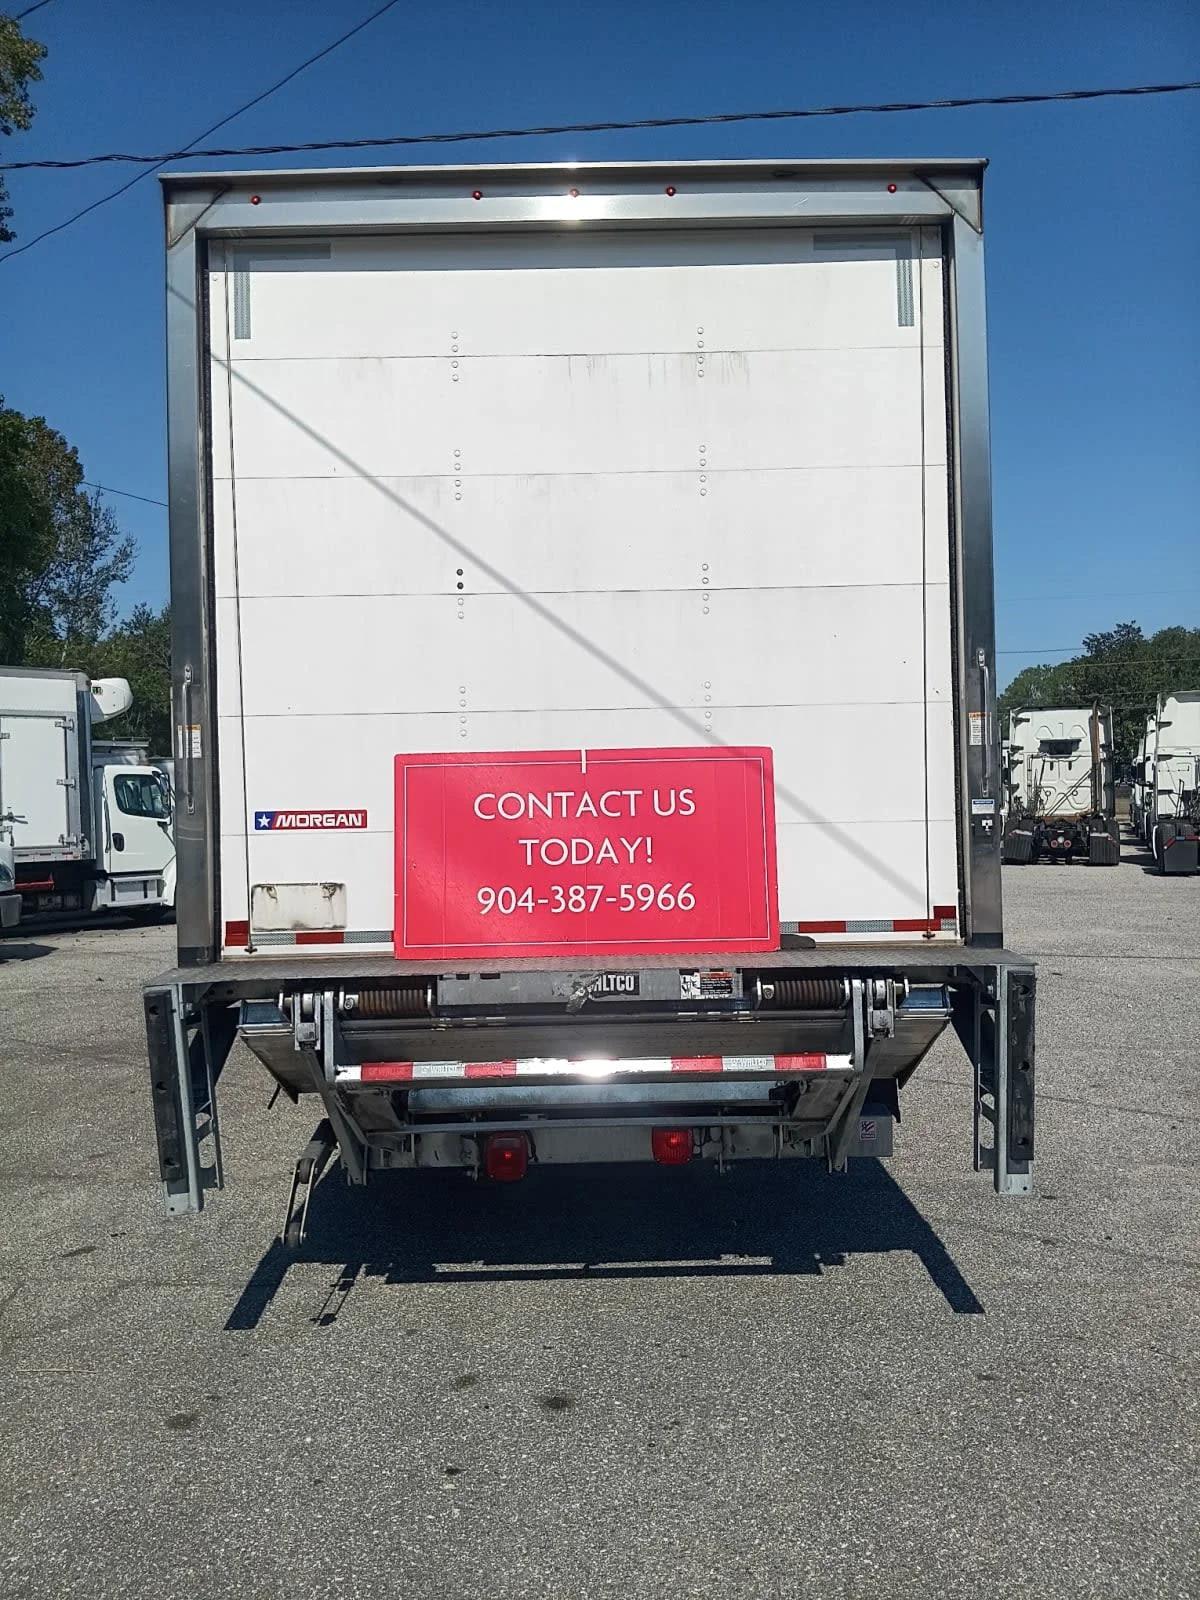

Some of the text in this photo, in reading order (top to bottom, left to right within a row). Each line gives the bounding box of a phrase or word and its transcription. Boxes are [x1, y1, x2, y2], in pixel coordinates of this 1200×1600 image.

[473, 788, 696, 820] CONTACT US
[275, 813, 362, 828] MORGAN
[518, 836, 654, 866] TODAY!
[477, 882, 696, 915] 904-387-5966
[589, 974, 635, 992] ALTCO
